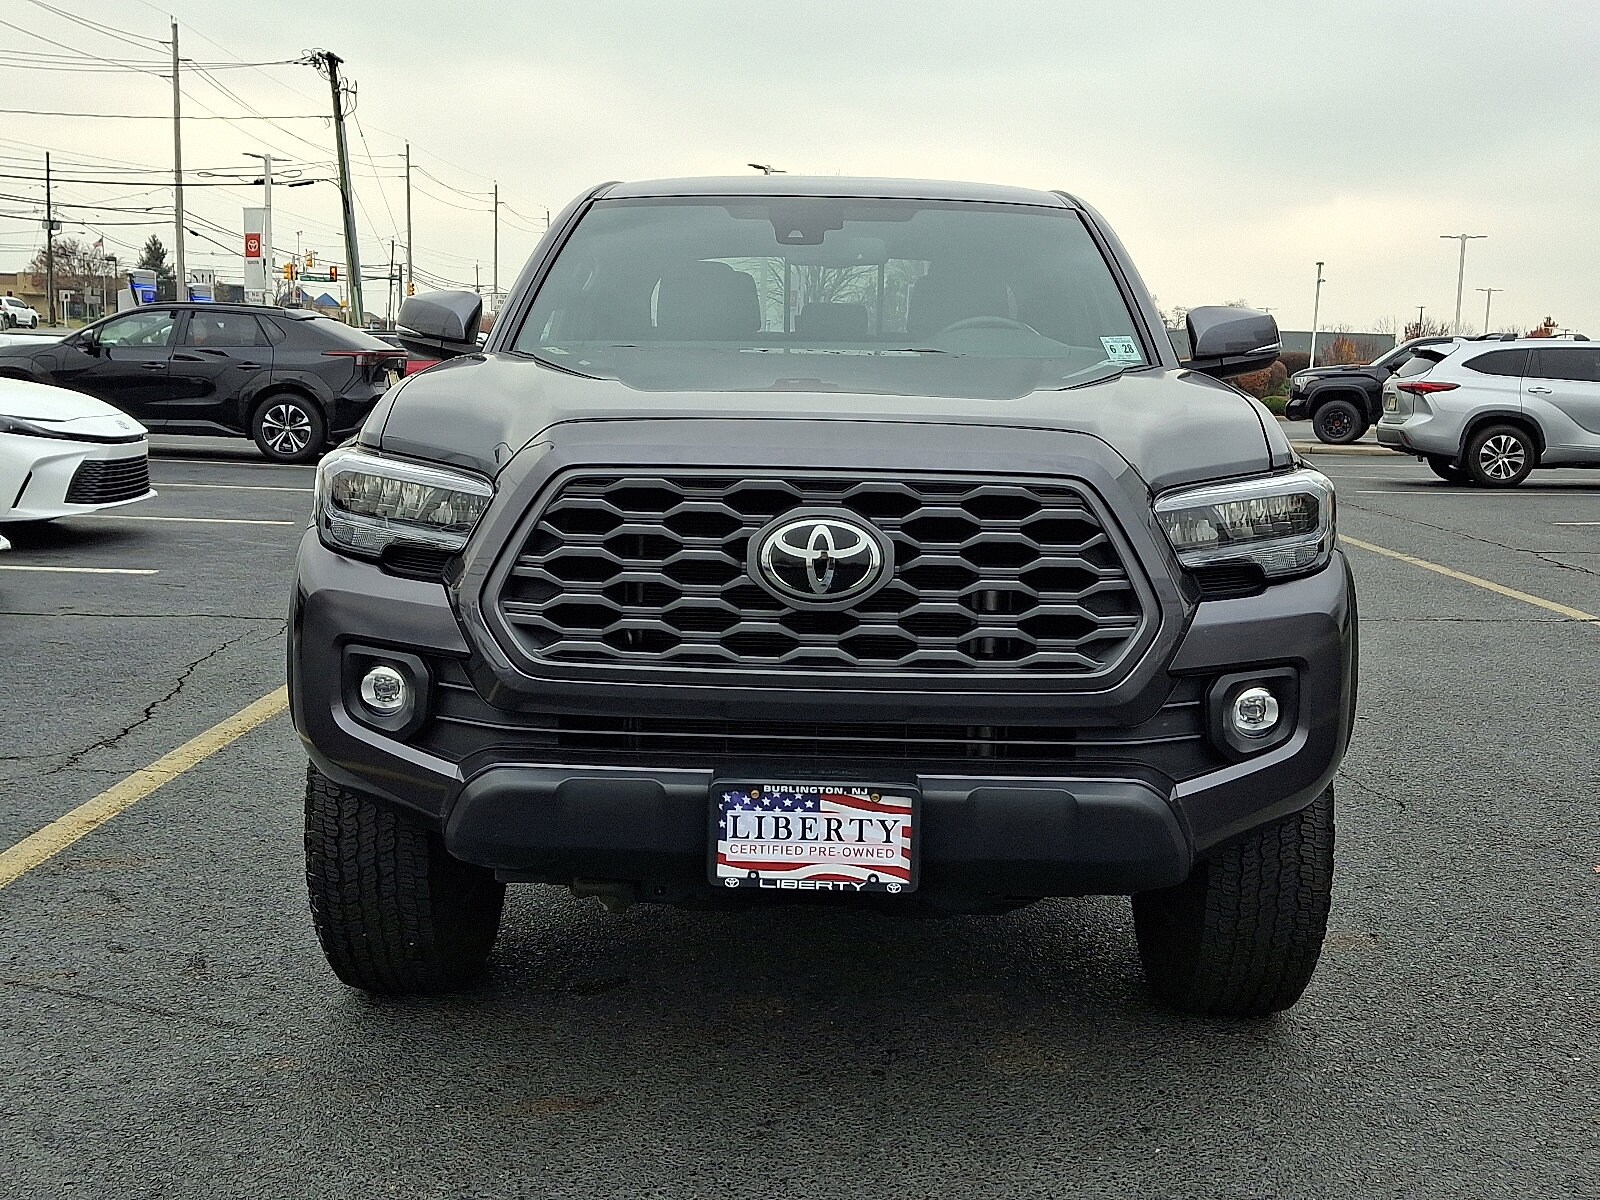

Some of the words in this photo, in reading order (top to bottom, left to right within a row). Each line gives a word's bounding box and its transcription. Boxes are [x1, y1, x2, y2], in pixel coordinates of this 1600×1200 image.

[1109, 344, 1117, 353] 6
[1121, 343, 1134, 353] 28
[763, 785, 848, 795] BURLINGTON,
[851, 787, 868, 795] NJ
[728, 814, 901, 844] LIBERTY
[729, 844, 804, 856] CERTIFIED
[809, 846, 895, 858] PRE-OWNED
[759, 878, 868, 892] LIBERTY
